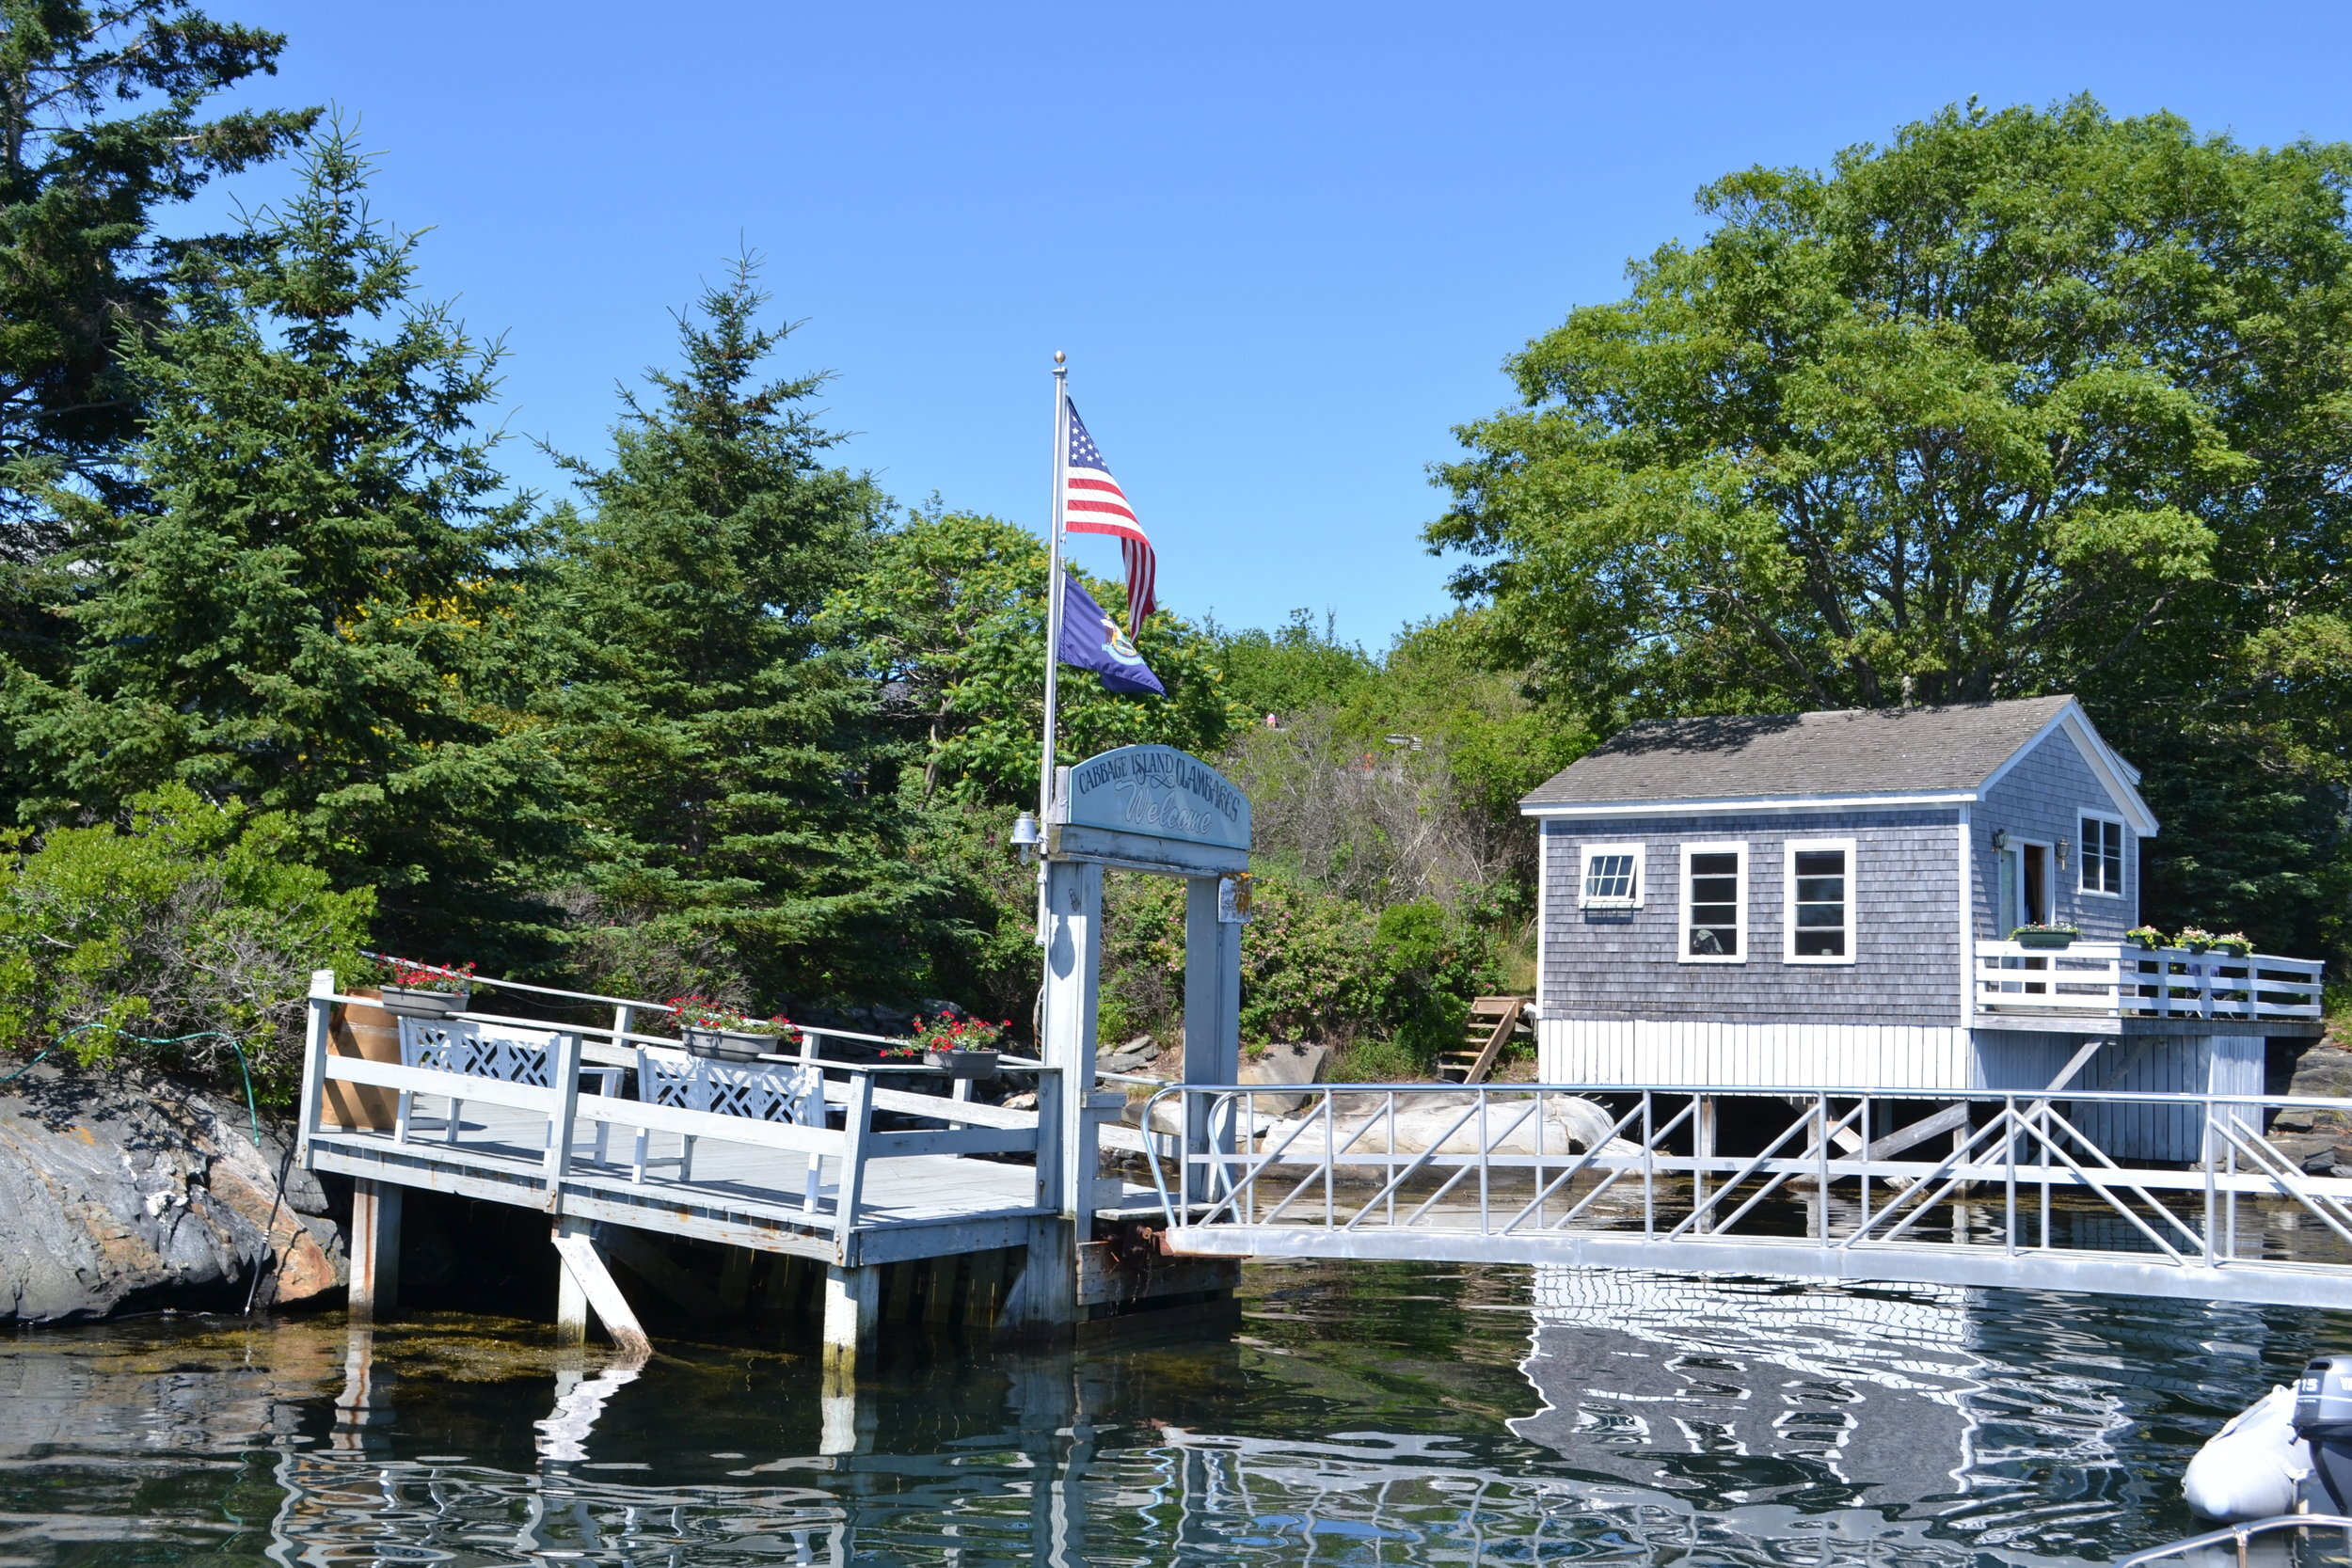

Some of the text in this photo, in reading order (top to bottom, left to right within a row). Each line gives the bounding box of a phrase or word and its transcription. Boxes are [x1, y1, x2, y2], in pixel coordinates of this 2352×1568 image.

[1079, 752, 1240, 822] CABBAGE ISLAND CLAMBAKES
[1115, 779, 1212, 834] Welcome
[2301, 1378, 2319, 1392] 15
